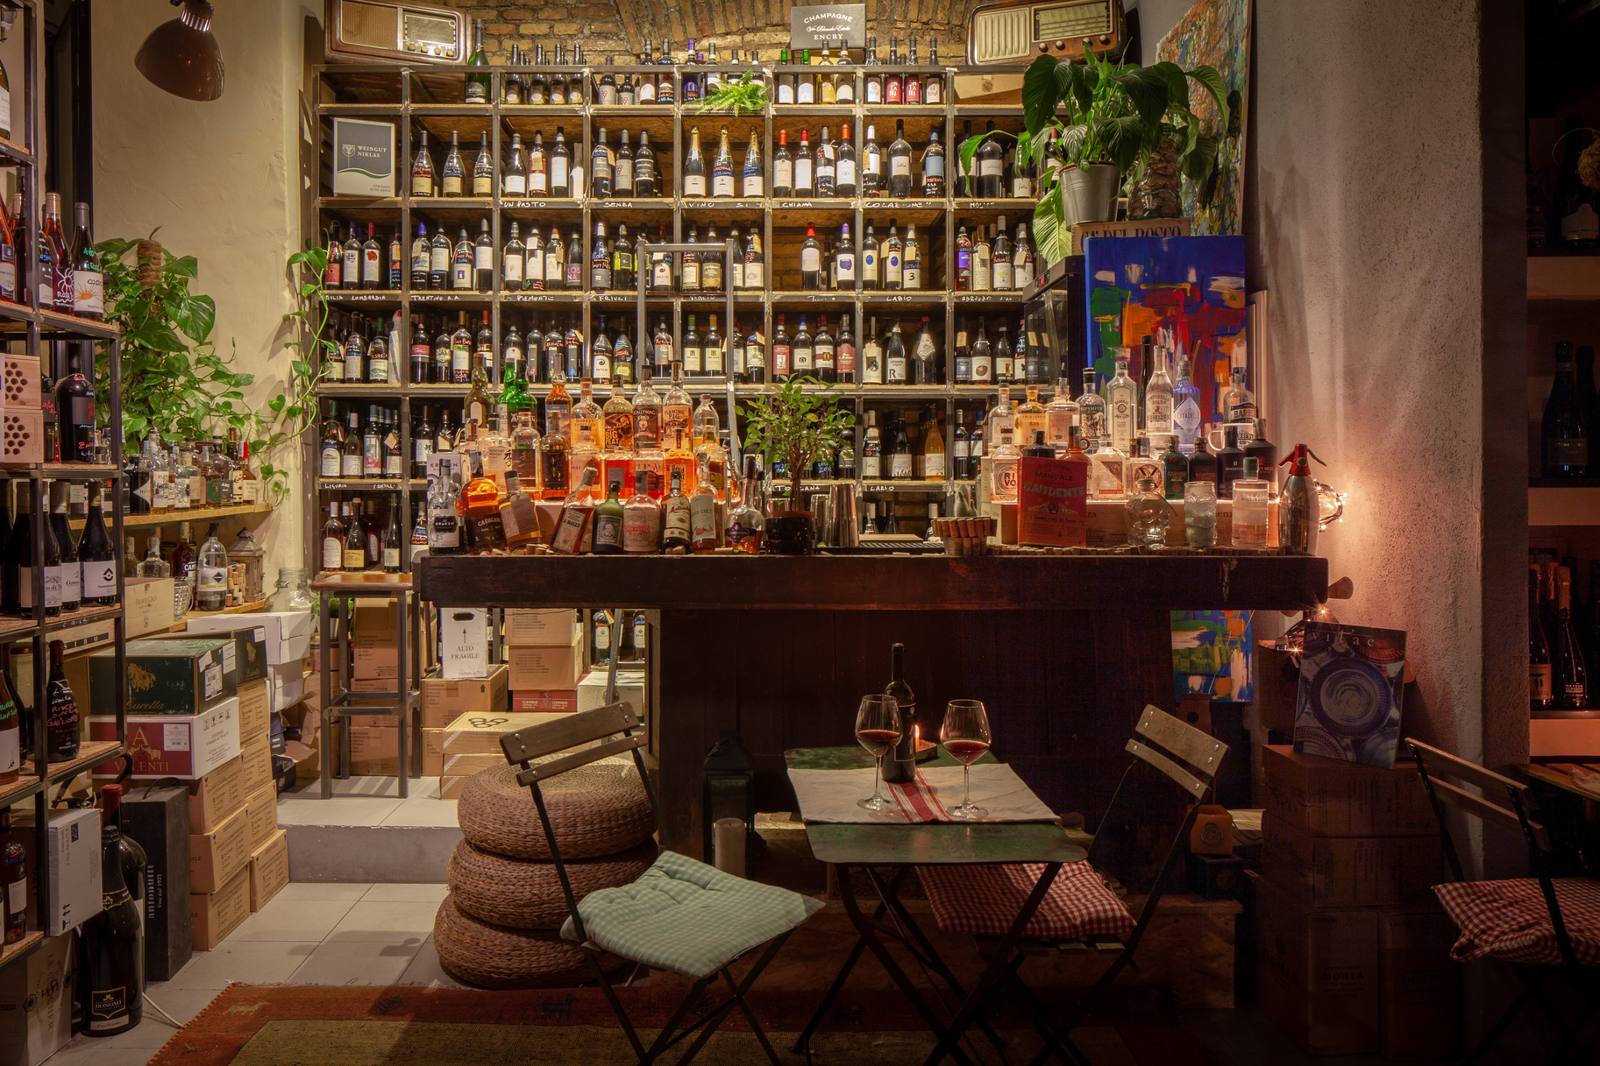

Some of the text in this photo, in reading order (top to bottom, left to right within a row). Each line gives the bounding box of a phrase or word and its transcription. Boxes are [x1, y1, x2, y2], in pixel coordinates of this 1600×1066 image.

[803, 12, 854, 24] CHAMPAGNE
[813, 33, 844, 41] ENCRY
[357, 145, 388, 153] WEINGUT
[357, 151, 381, 159] NIKLAS
[908, 272, 916, 281] 3
[889, 368, 896, 379] R
[605, 431, 618, 439] BIG
[132, 726, 149, 746] A
[113, 761, 169, 772] VLENTI
